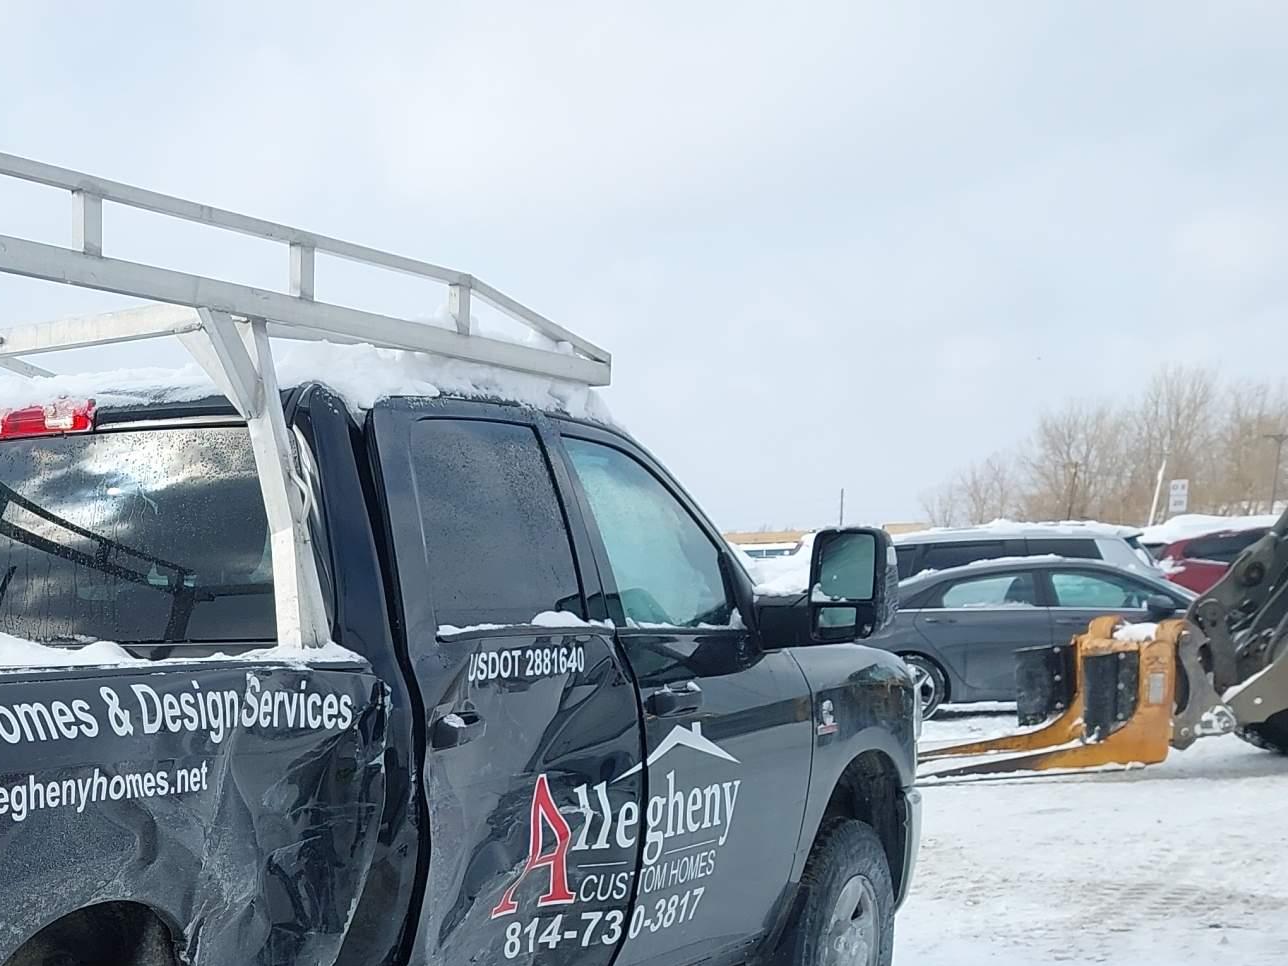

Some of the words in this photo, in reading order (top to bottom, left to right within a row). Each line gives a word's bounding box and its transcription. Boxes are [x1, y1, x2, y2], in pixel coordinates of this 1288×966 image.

[467, 649, 522, 682] USDOT
[525, 646, 585, 676] 2881640
[99, 686, 134, 737] &
[130, 679, 239, 744] Design
[241, 675, 353, 730] Services
[491, 772, 741, 920] Allegheny
[579, 863, 668, 902] CUSTOM
[668, 849, 716, 886] HOMES
[503, 886, 706, 959] 814-730-3817
